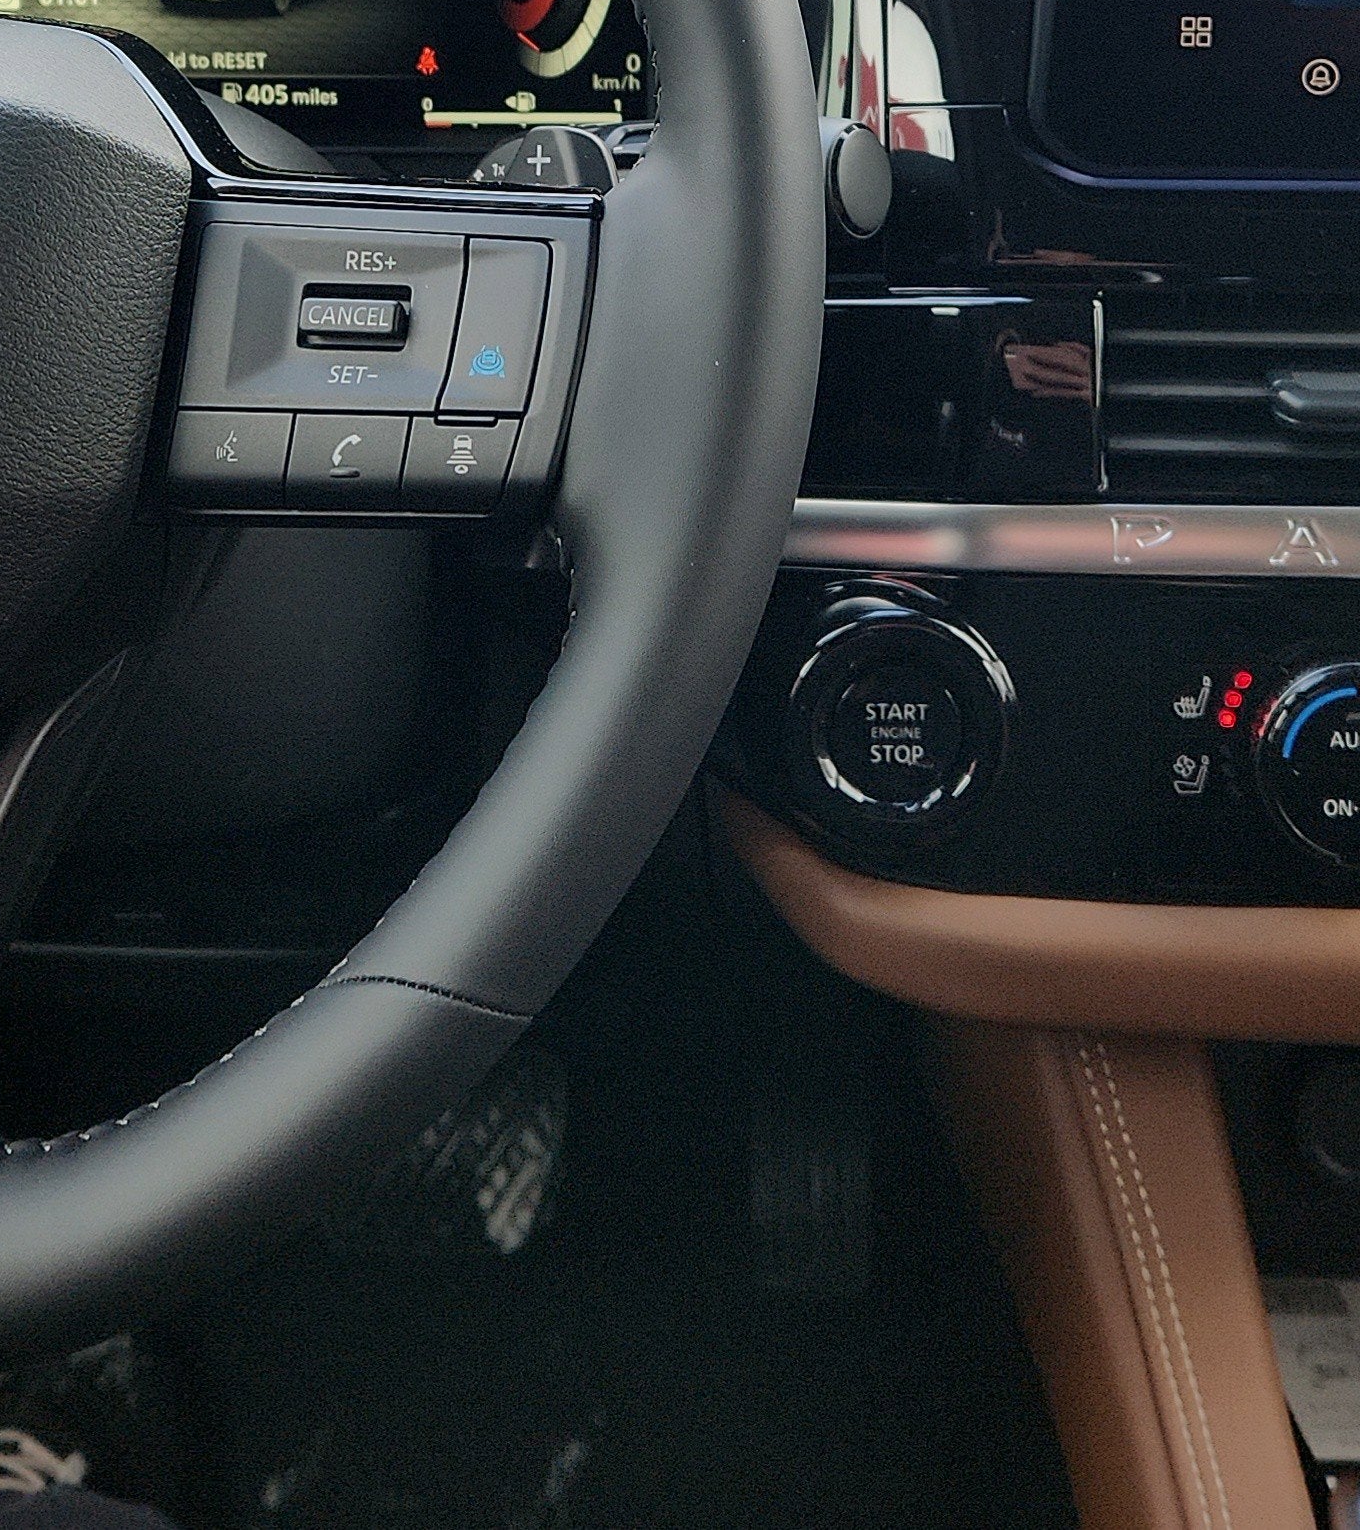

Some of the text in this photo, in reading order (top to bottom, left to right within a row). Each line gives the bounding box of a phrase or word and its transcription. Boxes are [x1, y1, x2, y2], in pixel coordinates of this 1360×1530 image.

[191, 53, 210, 69] to
[212, 52, 267, 70] RESET
[592, 74, 641, 91] km/h
[245, 84, 338, 106] 405 miles
[308, 305, 389, 327] CANCEL
[865, 702, 928, 722] START
[871, 727, 921, 739] ENGINE
[870, 743, 924, 764] STOP
